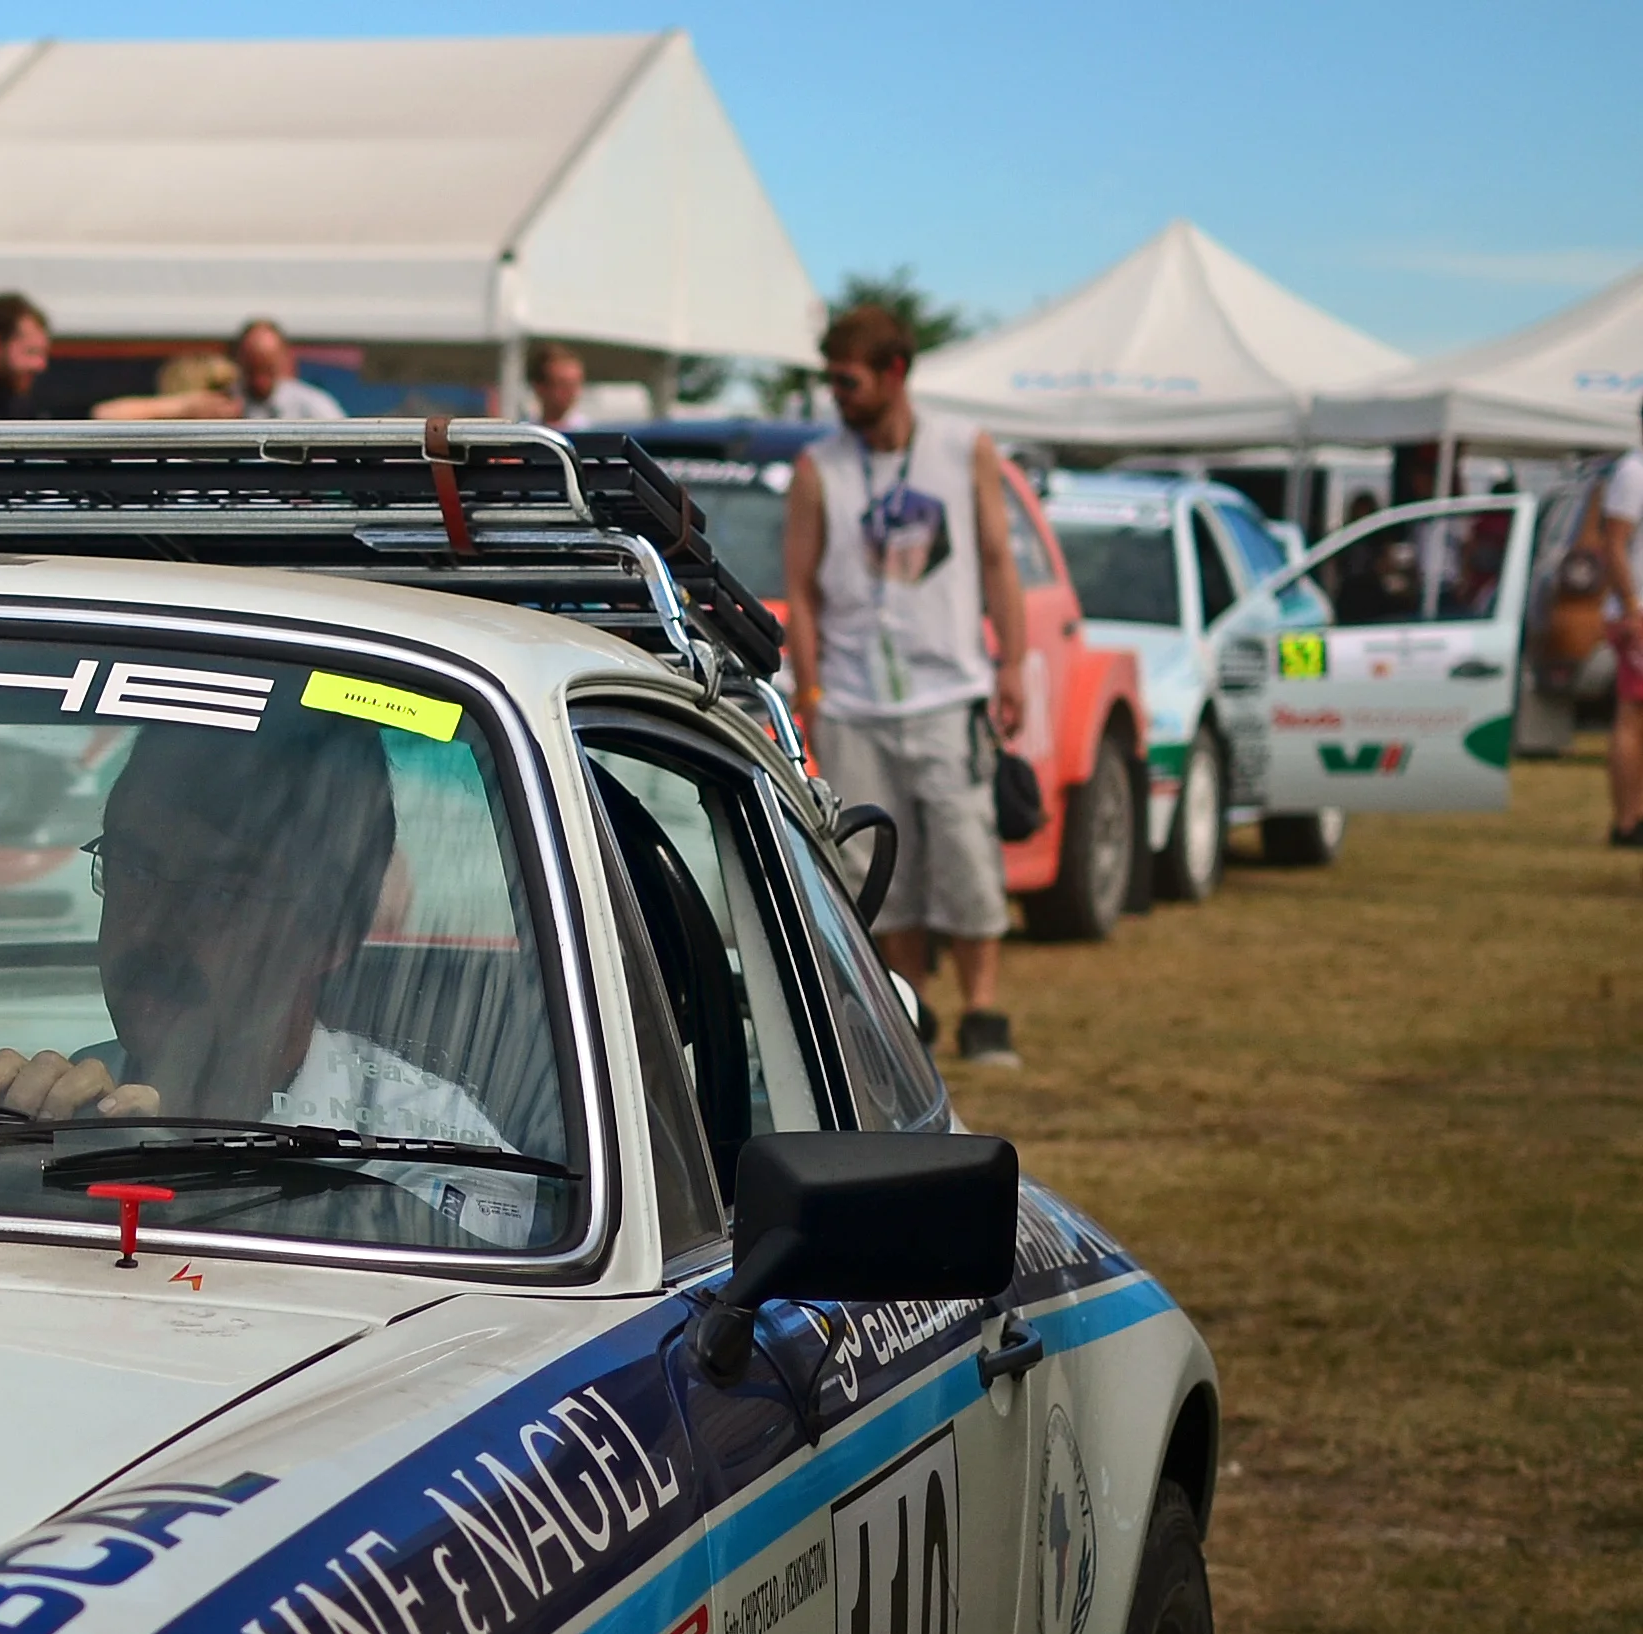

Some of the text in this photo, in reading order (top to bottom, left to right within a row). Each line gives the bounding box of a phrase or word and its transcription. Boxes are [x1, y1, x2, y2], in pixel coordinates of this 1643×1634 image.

[345, 693, 418, 716] HILL RUN
[423, 1386, 681, 1622] NAGEL
